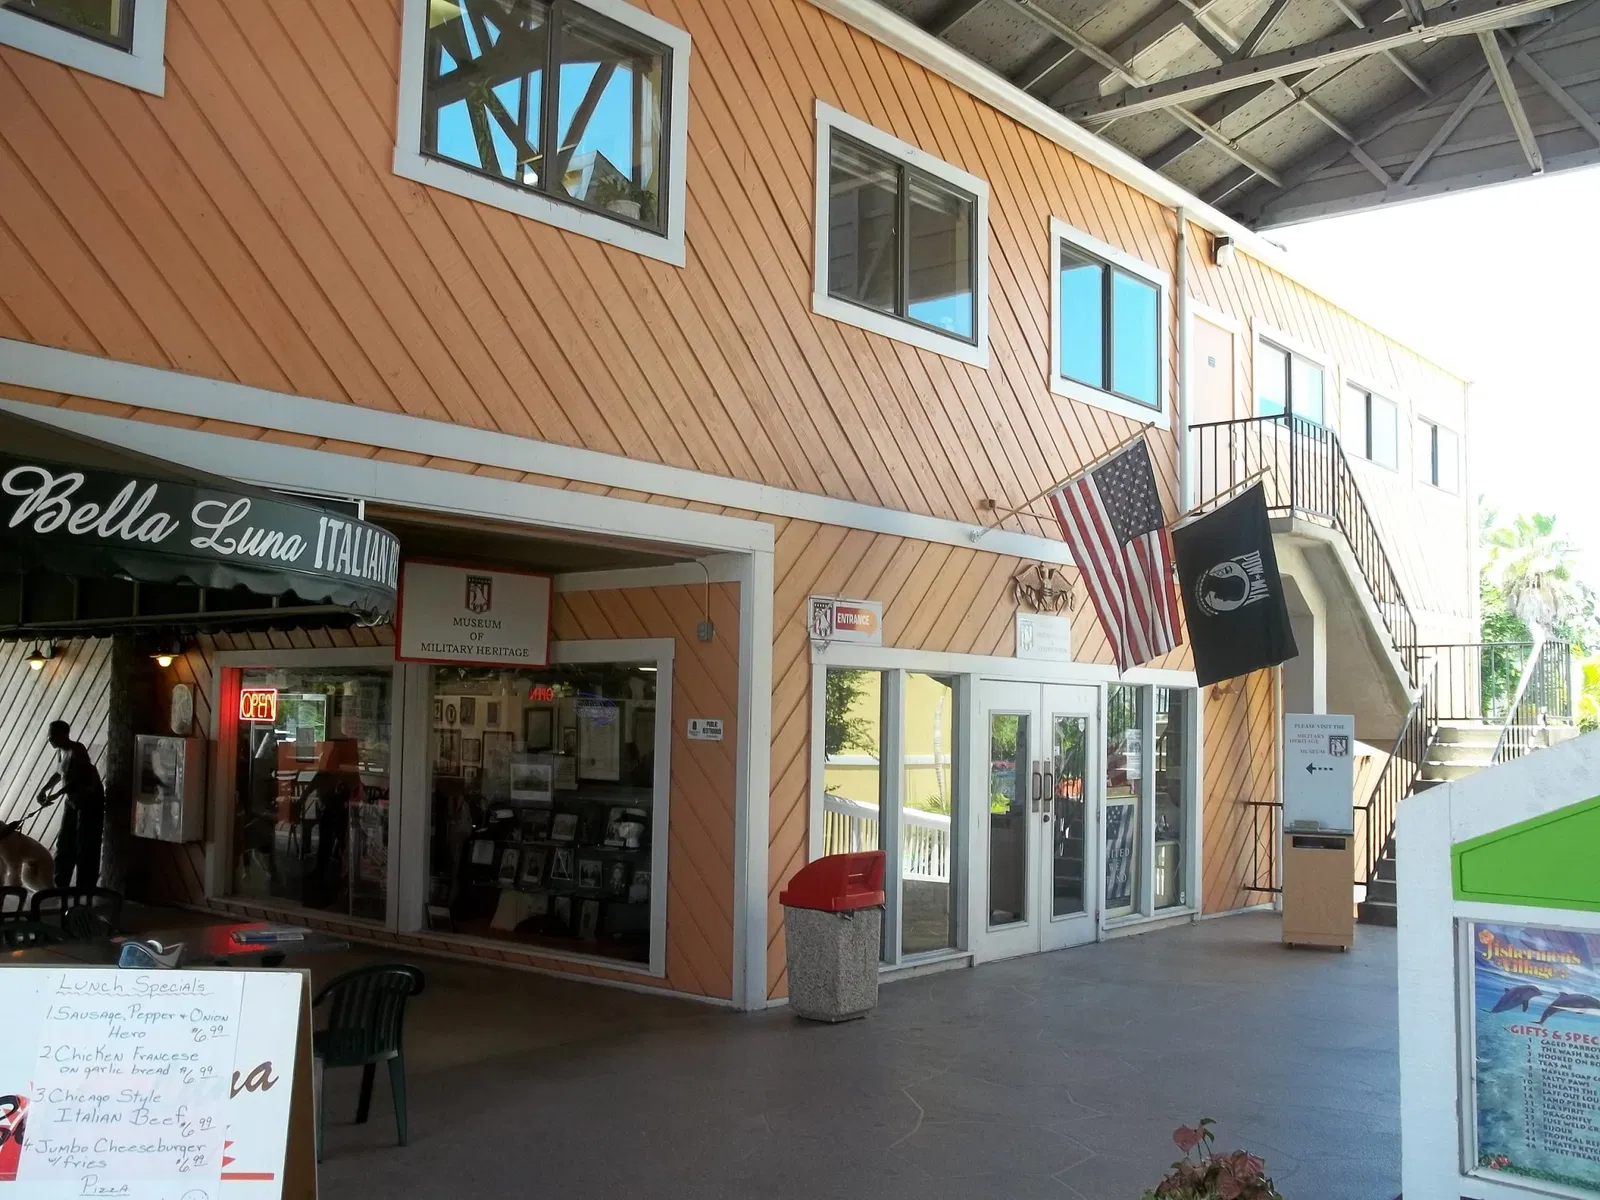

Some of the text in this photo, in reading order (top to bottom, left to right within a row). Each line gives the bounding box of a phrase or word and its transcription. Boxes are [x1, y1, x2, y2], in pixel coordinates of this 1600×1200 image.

[2, 466, 179, 543] Bella
[190, 498, 307, 562] Luna
[313, 516, 390, 584] ITALIAN
[453, 617, 502, 629] MUSEUM
[837, 613, 869, 625] ENTRANCE
[469, 632, 484, 641] OF
[421, 642, 529, 658] MILITARY HERITAGE
[242, 693, 275, 718] OPEN
[127, 1003, 177, 1024] Pepper
[189, 1007, 229, 1023] Onion
[108, 1026, 147, 1039] Hero
[1510, 1024, 1600, 1046] GIFTS & SPEC
[1540, 1039, 1567, 1048] CAGED
[54, 1043, 124, 1062] Chicken
[132, 1046, 199, 1062] Francese
[1541, 1046, 1557, 1054] THE
[1559, 1048, 1582, 1057] WASH
[1538, 1052, 1573, 1064] HOOKED
[1575, 1057, 1588, 1066] ON
[59, 1065, 79, 1075] on
[84, 1064, 124, 1081] garlic
[131, 1063, 170, 1076] bread
[1541, 1068, 1570, 1077] NAPLES
[1571, 1072, 1591, 1081] SOAP
[1542, 1074, 1566, 1084] SALTY
[1568, 1078, 1590, 1087] PAWS
[1542, 1081, 1580, 1093] BENEATH
[1581, 1087, 1598, 1096] THE
[48, 1087, 110, 1108] Chicago
[119, 1089, 162, 1110] Style
[1542, 1096, 1565, 1105] SAND
[1566, 1100, 1596, 1110] PEBBLE
[1562, 1092, 1580, 1100] OUT
[53, 1107, 122, 1125] Italian
[129, 1105, 187, 1126] Beef
[1542, 1103, 1559, 1111] SEA
[1559, 1105, 1585, 1116] SPIRIT
[1542, 1110, 1593, 1125] DRAGONFLY
[1543, 1117, 1561, 1126] FUSE
[1563, 1120, 1586, 1130] WELD
[1543, 1124, 1573, 1134] BIJOUX
[1543, 1131, 1583, 1144] TROPICAL
[1543, 1138, 1577, 1150] PIRATES
[35, 1137, 88, 1154] Jumbo
[93, 1138, 207, 1159] Cheeseburger
[1544, 1146, 1571, 1156] SWEET
[63, 1155, 107, 1169] fries
[81, 1174, 129, 1194] Pizza
